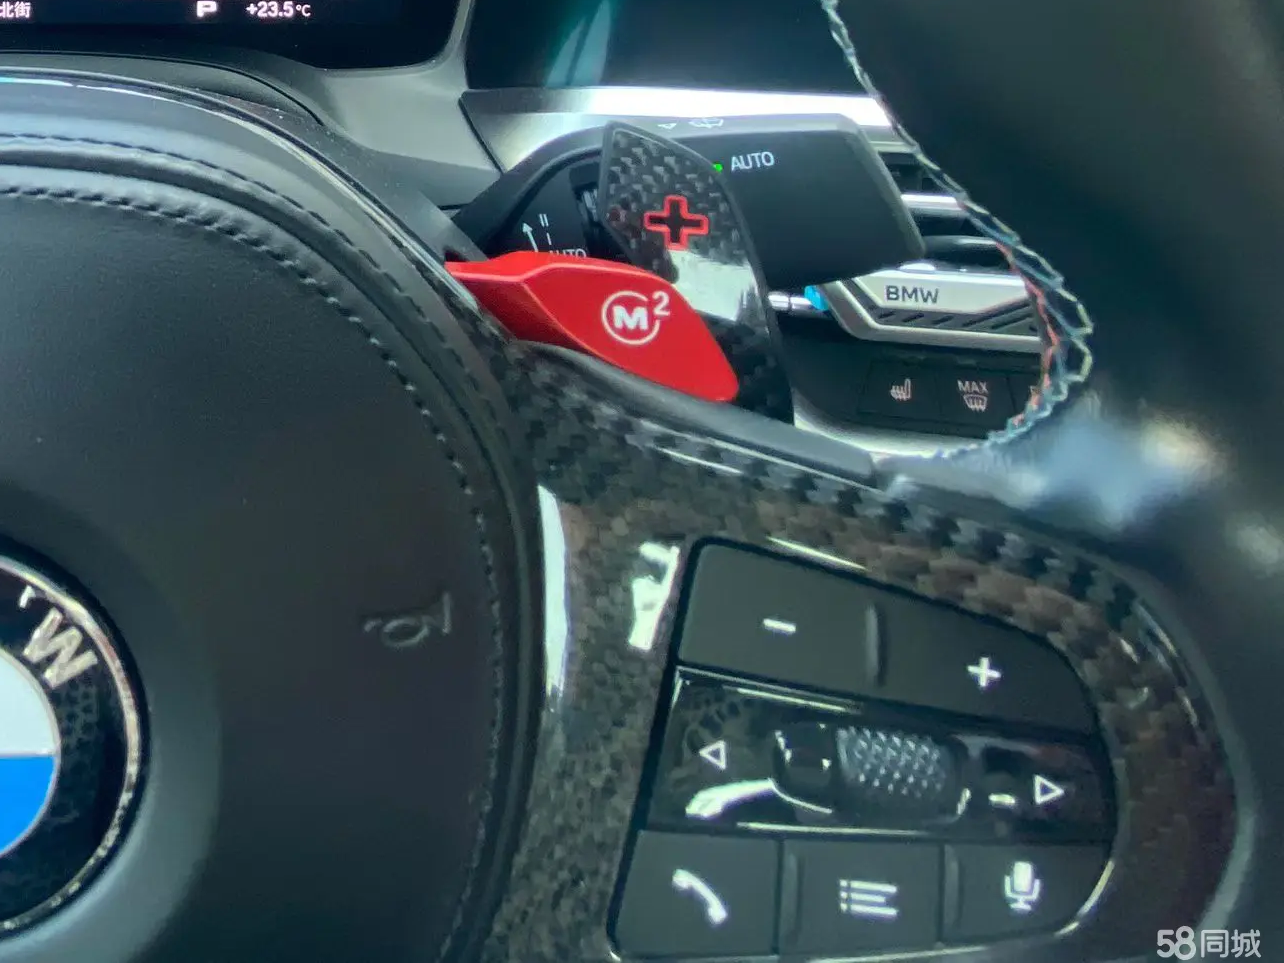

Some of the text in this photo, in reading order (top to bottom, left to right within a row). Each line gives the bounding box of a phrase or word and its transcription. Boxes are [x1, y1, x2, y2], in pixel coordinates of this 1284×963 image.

[196, 1, 217, 17] P
[246, 1, 294, 17] +23.5
[730, 151, 774, 172] AUTO
[885, 285, 939, 304] BMW
[958, 379, 989, 394] MAX
